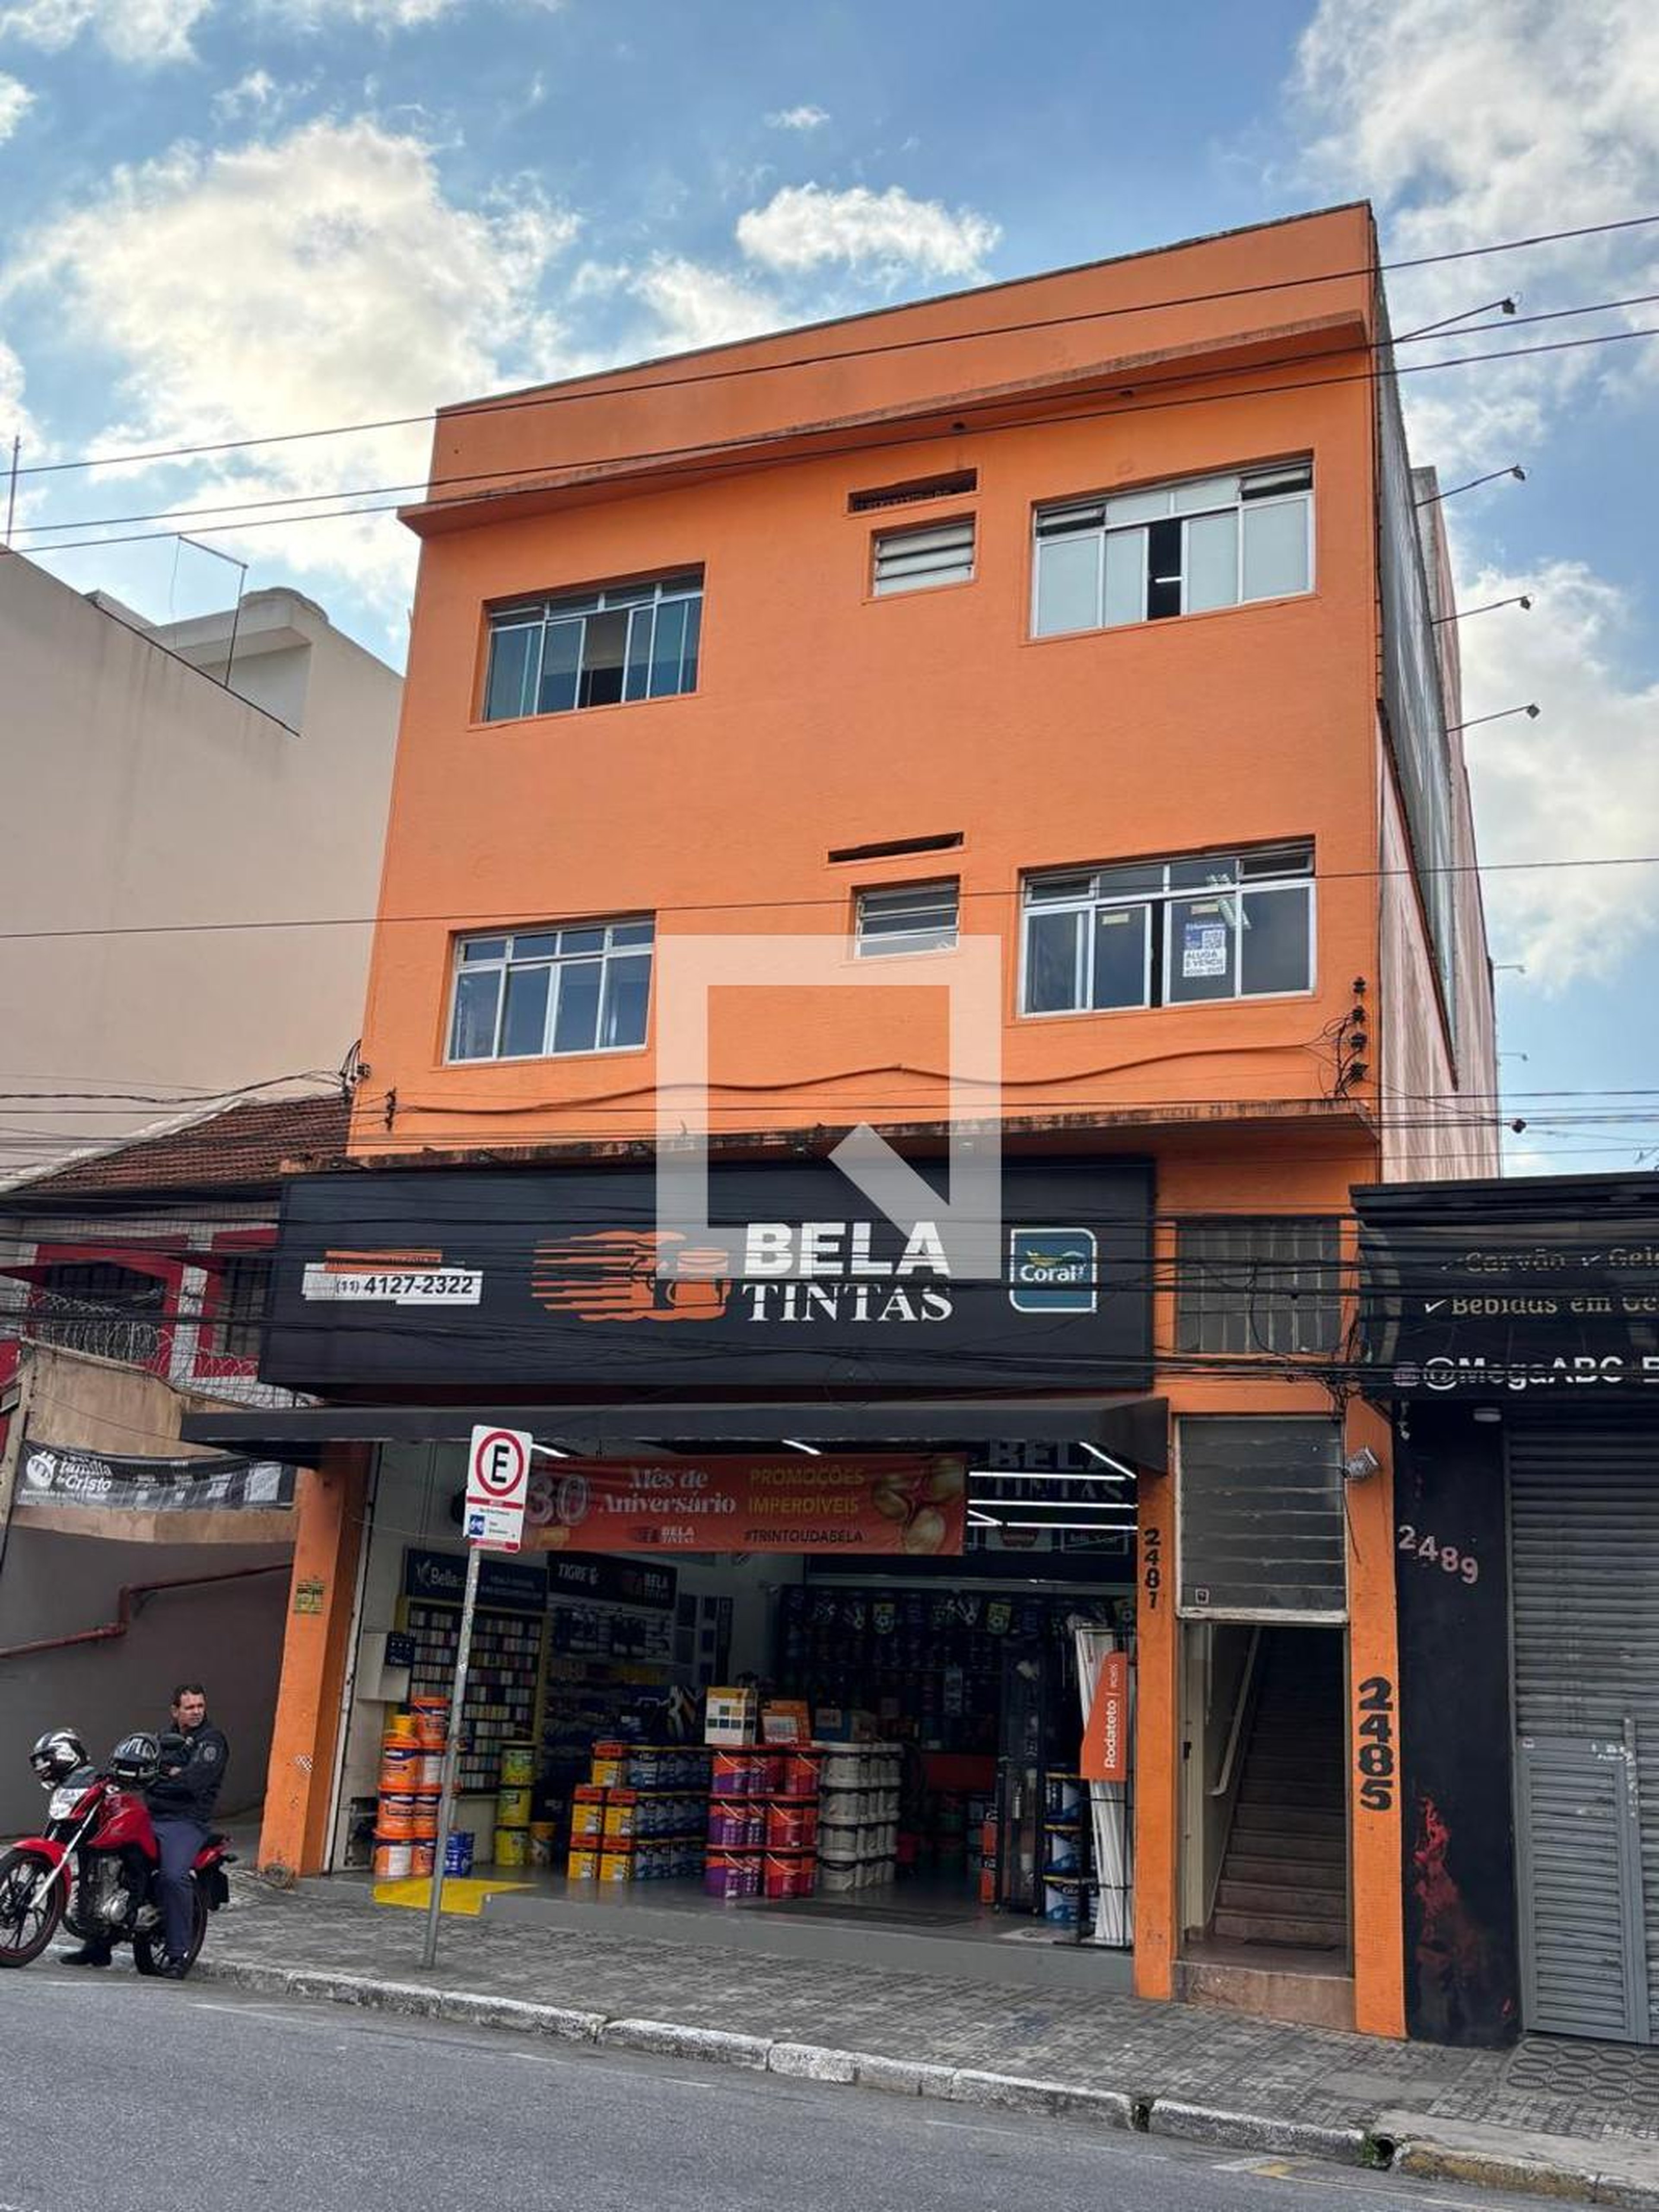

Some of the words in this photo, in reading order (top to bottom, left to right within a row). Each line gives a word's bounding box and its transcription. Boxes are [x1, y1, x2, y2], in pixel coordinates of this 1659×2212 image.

[744, 1222, 950, 1275] BELA
[336, 1279, 359, 1295] (11)
[364, 1275, 473, 1295] 4127-2322
[1020, 1264, 1076, 1282] Coral
[741, 1282, 953, 1321] TINTAS
[491, 1444, 510, 1483] E
[680, 1468, 708, 1489] de
[750, 1464, 864, 1486] PROMOÇÕES
[598, 1490, 736, 1513] Aniversário
[1398, 1525, 1478, 1584] 2489
[1104, 1700, 1117, 1769] Rodateto
[1359, 1677, 1394, 1810] 2485
